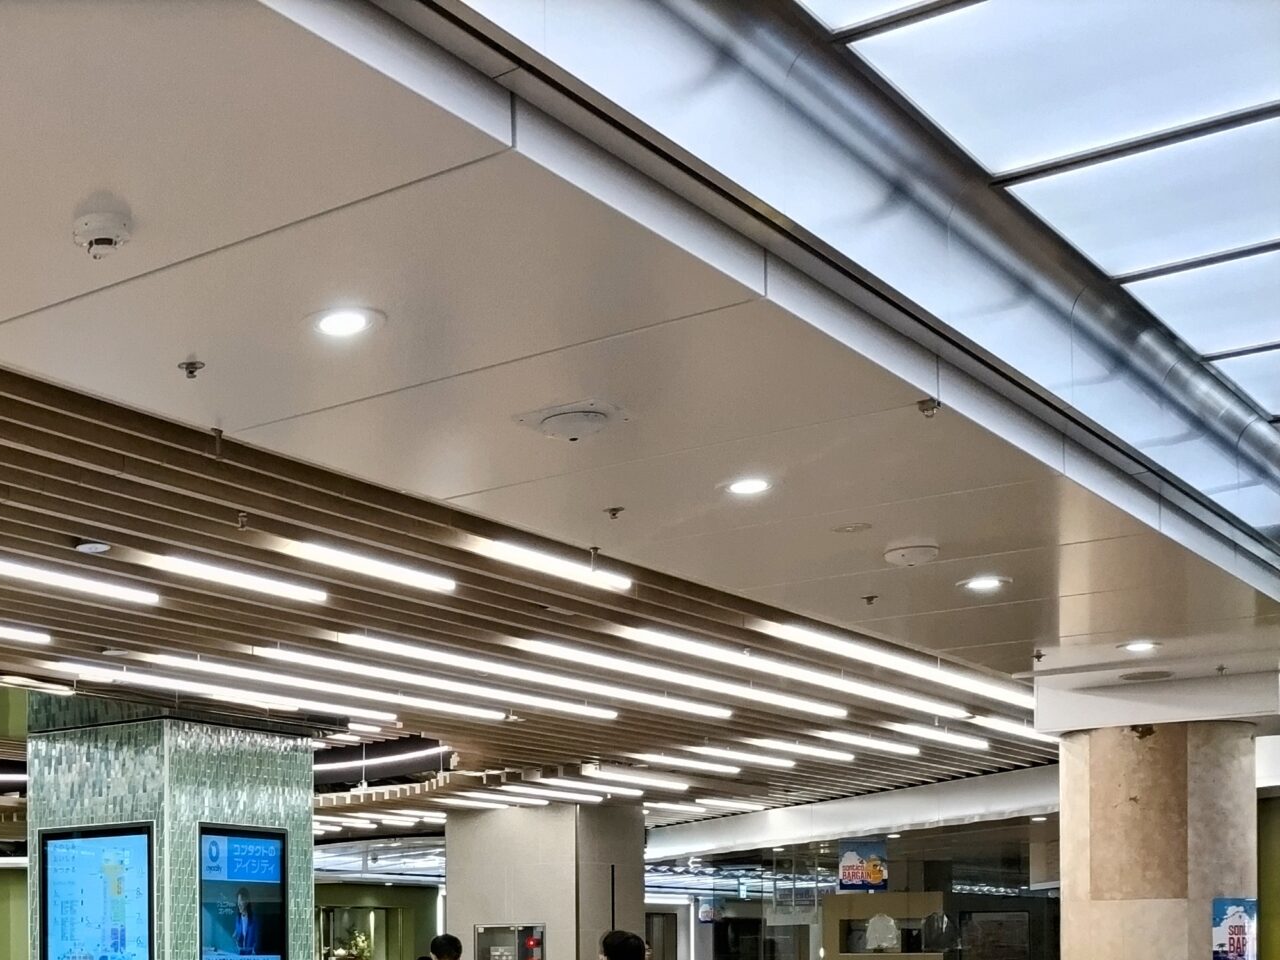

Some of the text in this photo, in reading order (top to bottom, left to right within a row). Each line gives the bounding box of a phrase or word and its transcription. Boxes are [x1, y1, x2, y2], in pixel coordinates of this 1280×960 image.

[233, 844, 276, 857] コンタクトの
[233, 858, 276, 873] アイシティ
[842, 871, 872, 880] BARGAIN
